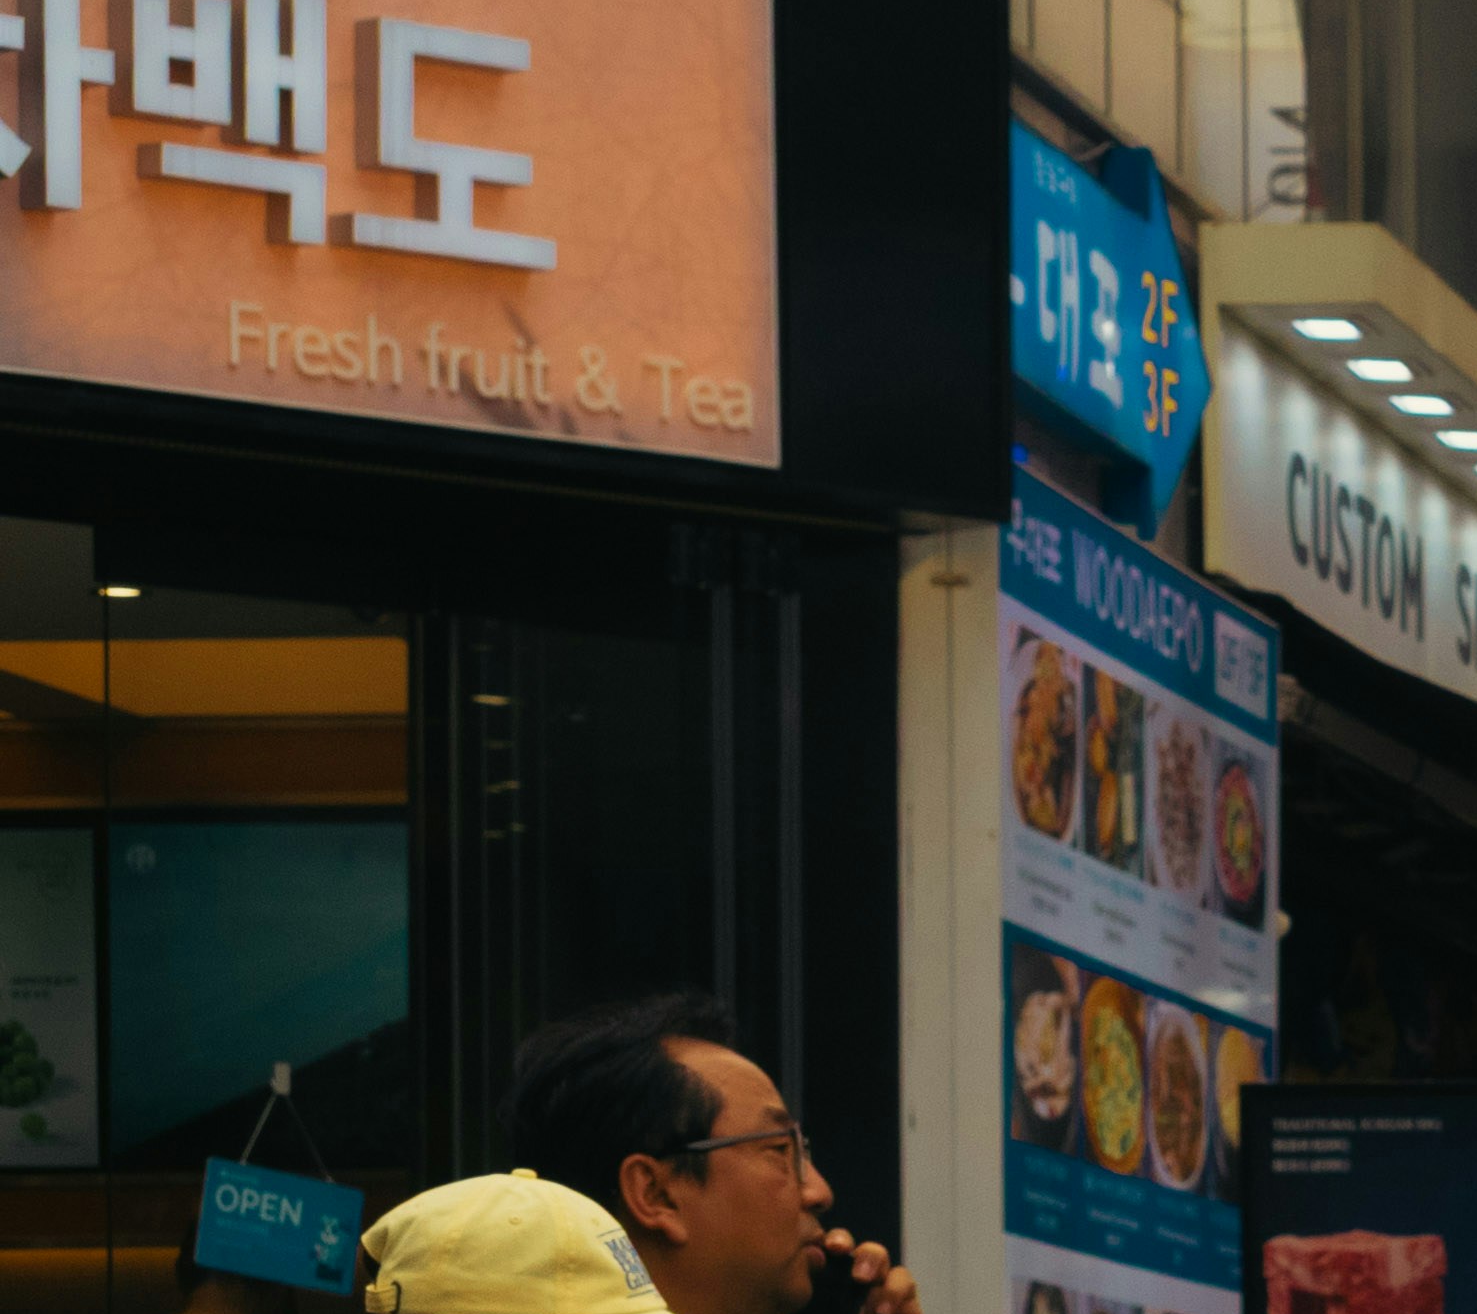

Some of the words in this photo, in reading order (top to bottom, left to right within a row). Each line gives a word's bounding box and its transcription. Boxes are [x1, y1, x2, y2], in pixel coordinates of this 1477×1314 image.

[227, 301, 402, 390] Fresh
[426, 322, 551, 408] fruit
[577, 345, 623, 416] &
[642, 356, 755, 434] Tea
[1010, 221, 1124, 410] 대포
[1141, 271, 1179, 348] 2F
[1143, 360, 1179, 438] 3F
[1072, 528, 1200, 674] WOODAEPO
[1287, 453, 1428, 643] CUSTOM
[214, 1181, 303, 1227] OPEN
